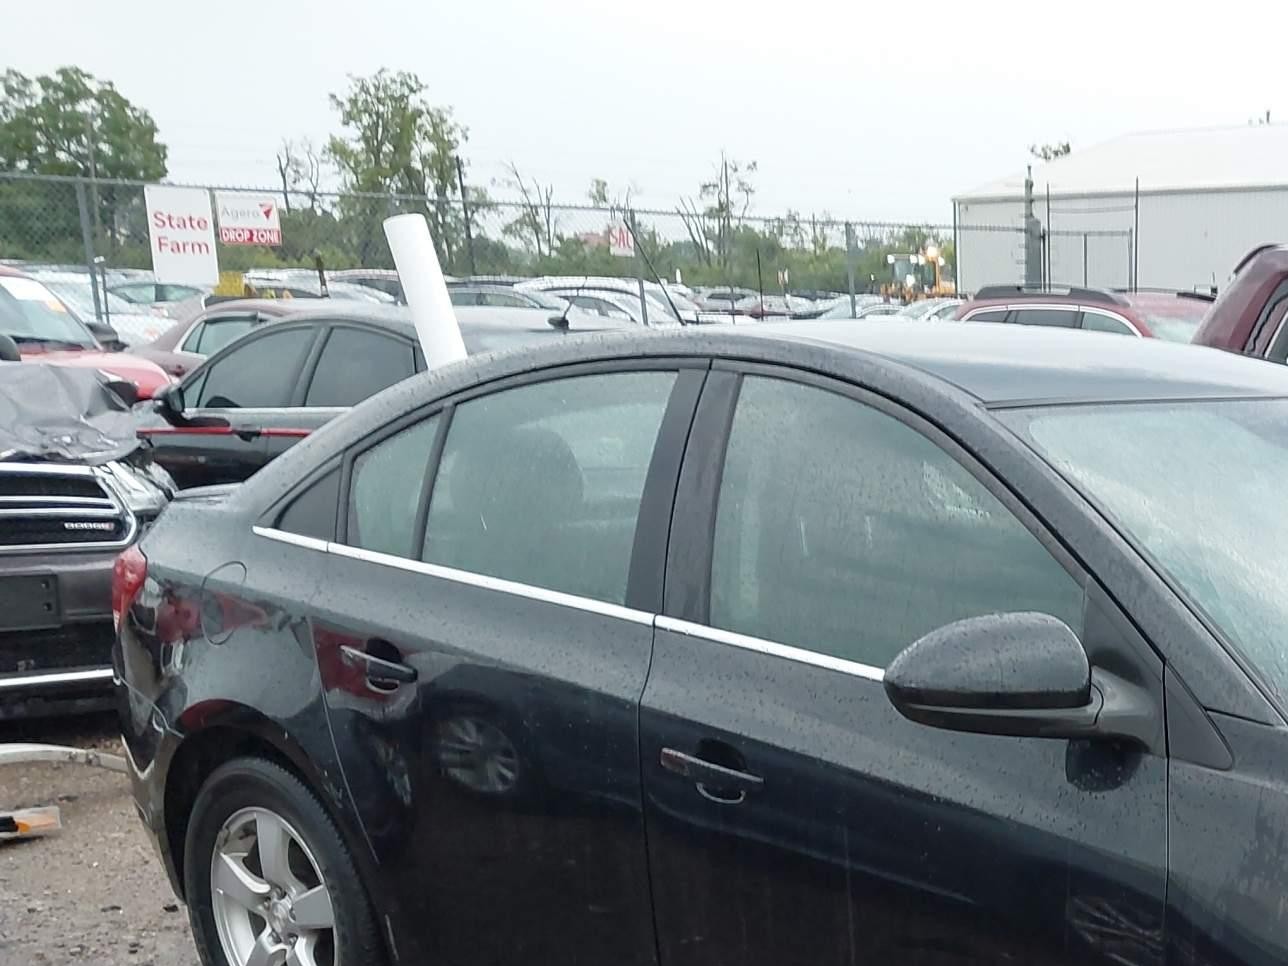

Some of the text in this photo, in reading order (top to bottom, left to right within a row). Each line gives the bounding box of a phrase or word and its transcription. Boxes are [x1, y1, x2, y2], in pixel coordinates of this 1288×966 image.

[153, 211, 208, 230] State
[158, 236, 209, 255] Farm
[221, 229, 280, 244] DROP ZONE
